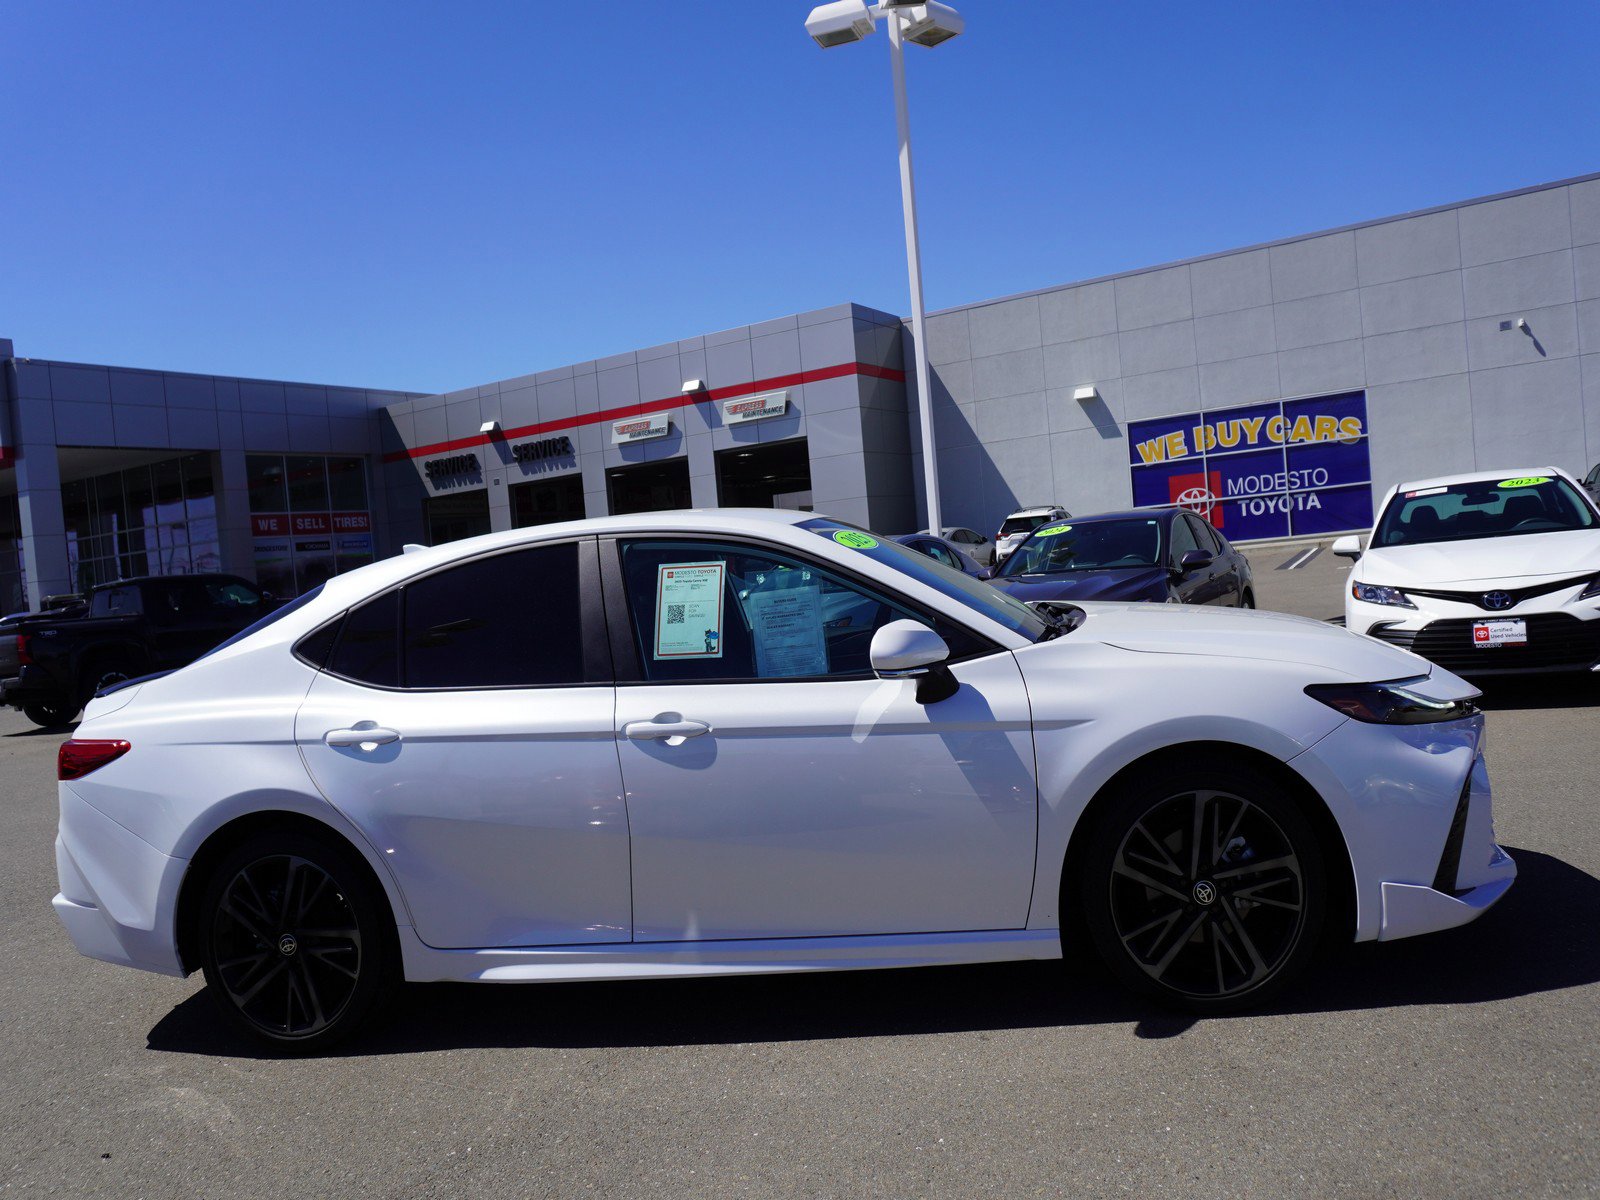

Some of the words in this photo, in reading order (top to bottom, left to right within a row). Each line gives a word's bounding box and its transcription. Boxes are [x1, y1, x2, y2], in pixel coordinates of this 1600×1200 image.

[735, 400, 763, 412] EXPRESS
[742, 405, 783, 419] MAINTENANCE
[623, 422, 649, 433] EXPRESS
[629, 427, 666, 439] MAINTENANCE
[1136, 430, 1188, 466] WE
[1192, 416, 1266, 453] BUY
[1266, 415, 1362, 444] CARS
[512, 436, 570, 463] SERVICE
[424, 453, 477, 478] SERVICE
[1227, 467, 1329, 496] MODESTO
[1507, 477, 1541, 487] 2023
[1238, 492, 1322, 517] TOYOTA
[258, 518, 278, 531] WE
[296, 517, 325, 529] SELL
[334, 516, 368, 528] TIRES!
